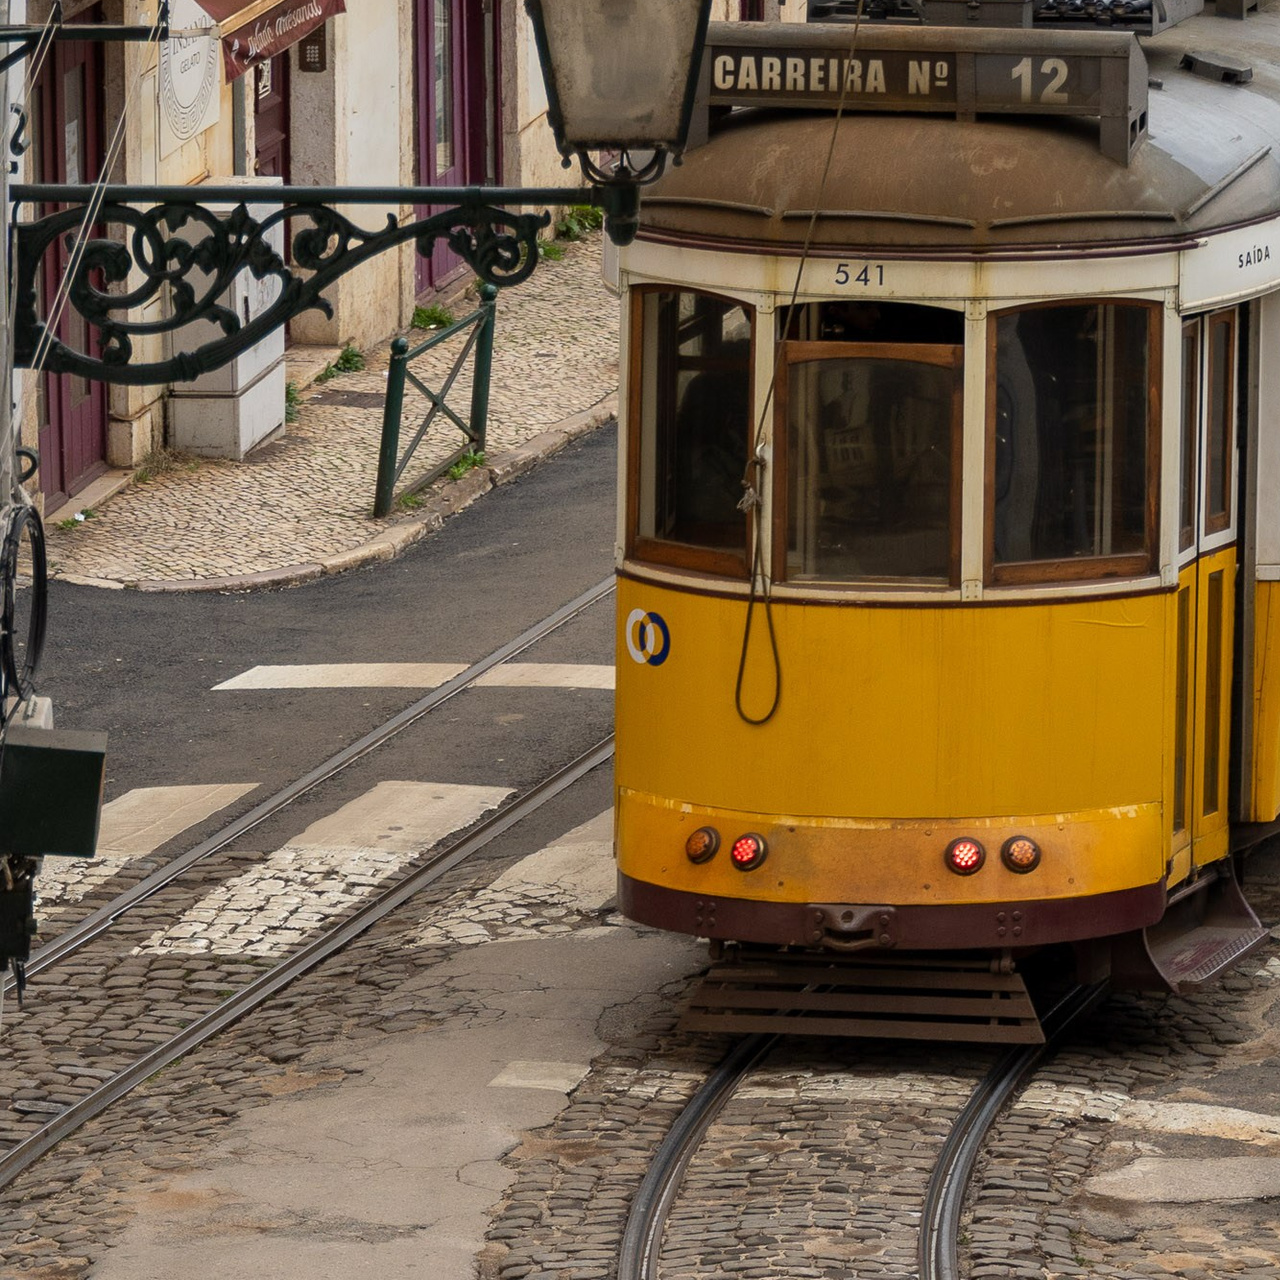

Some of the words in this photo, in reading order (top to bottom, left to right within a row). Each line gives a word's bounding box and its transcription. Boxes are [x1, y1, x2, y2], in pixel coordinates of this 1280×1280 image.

[179, 51, 201, 74] GELATO
[713, 54, 887, 94] CARREIRA
[908, 60, 949, 95] Nº
[1010, 57, 1069, 104] 12
[1238, 244, 1271, 269] SAÍDA
[834, 263, 884, 287] 541
